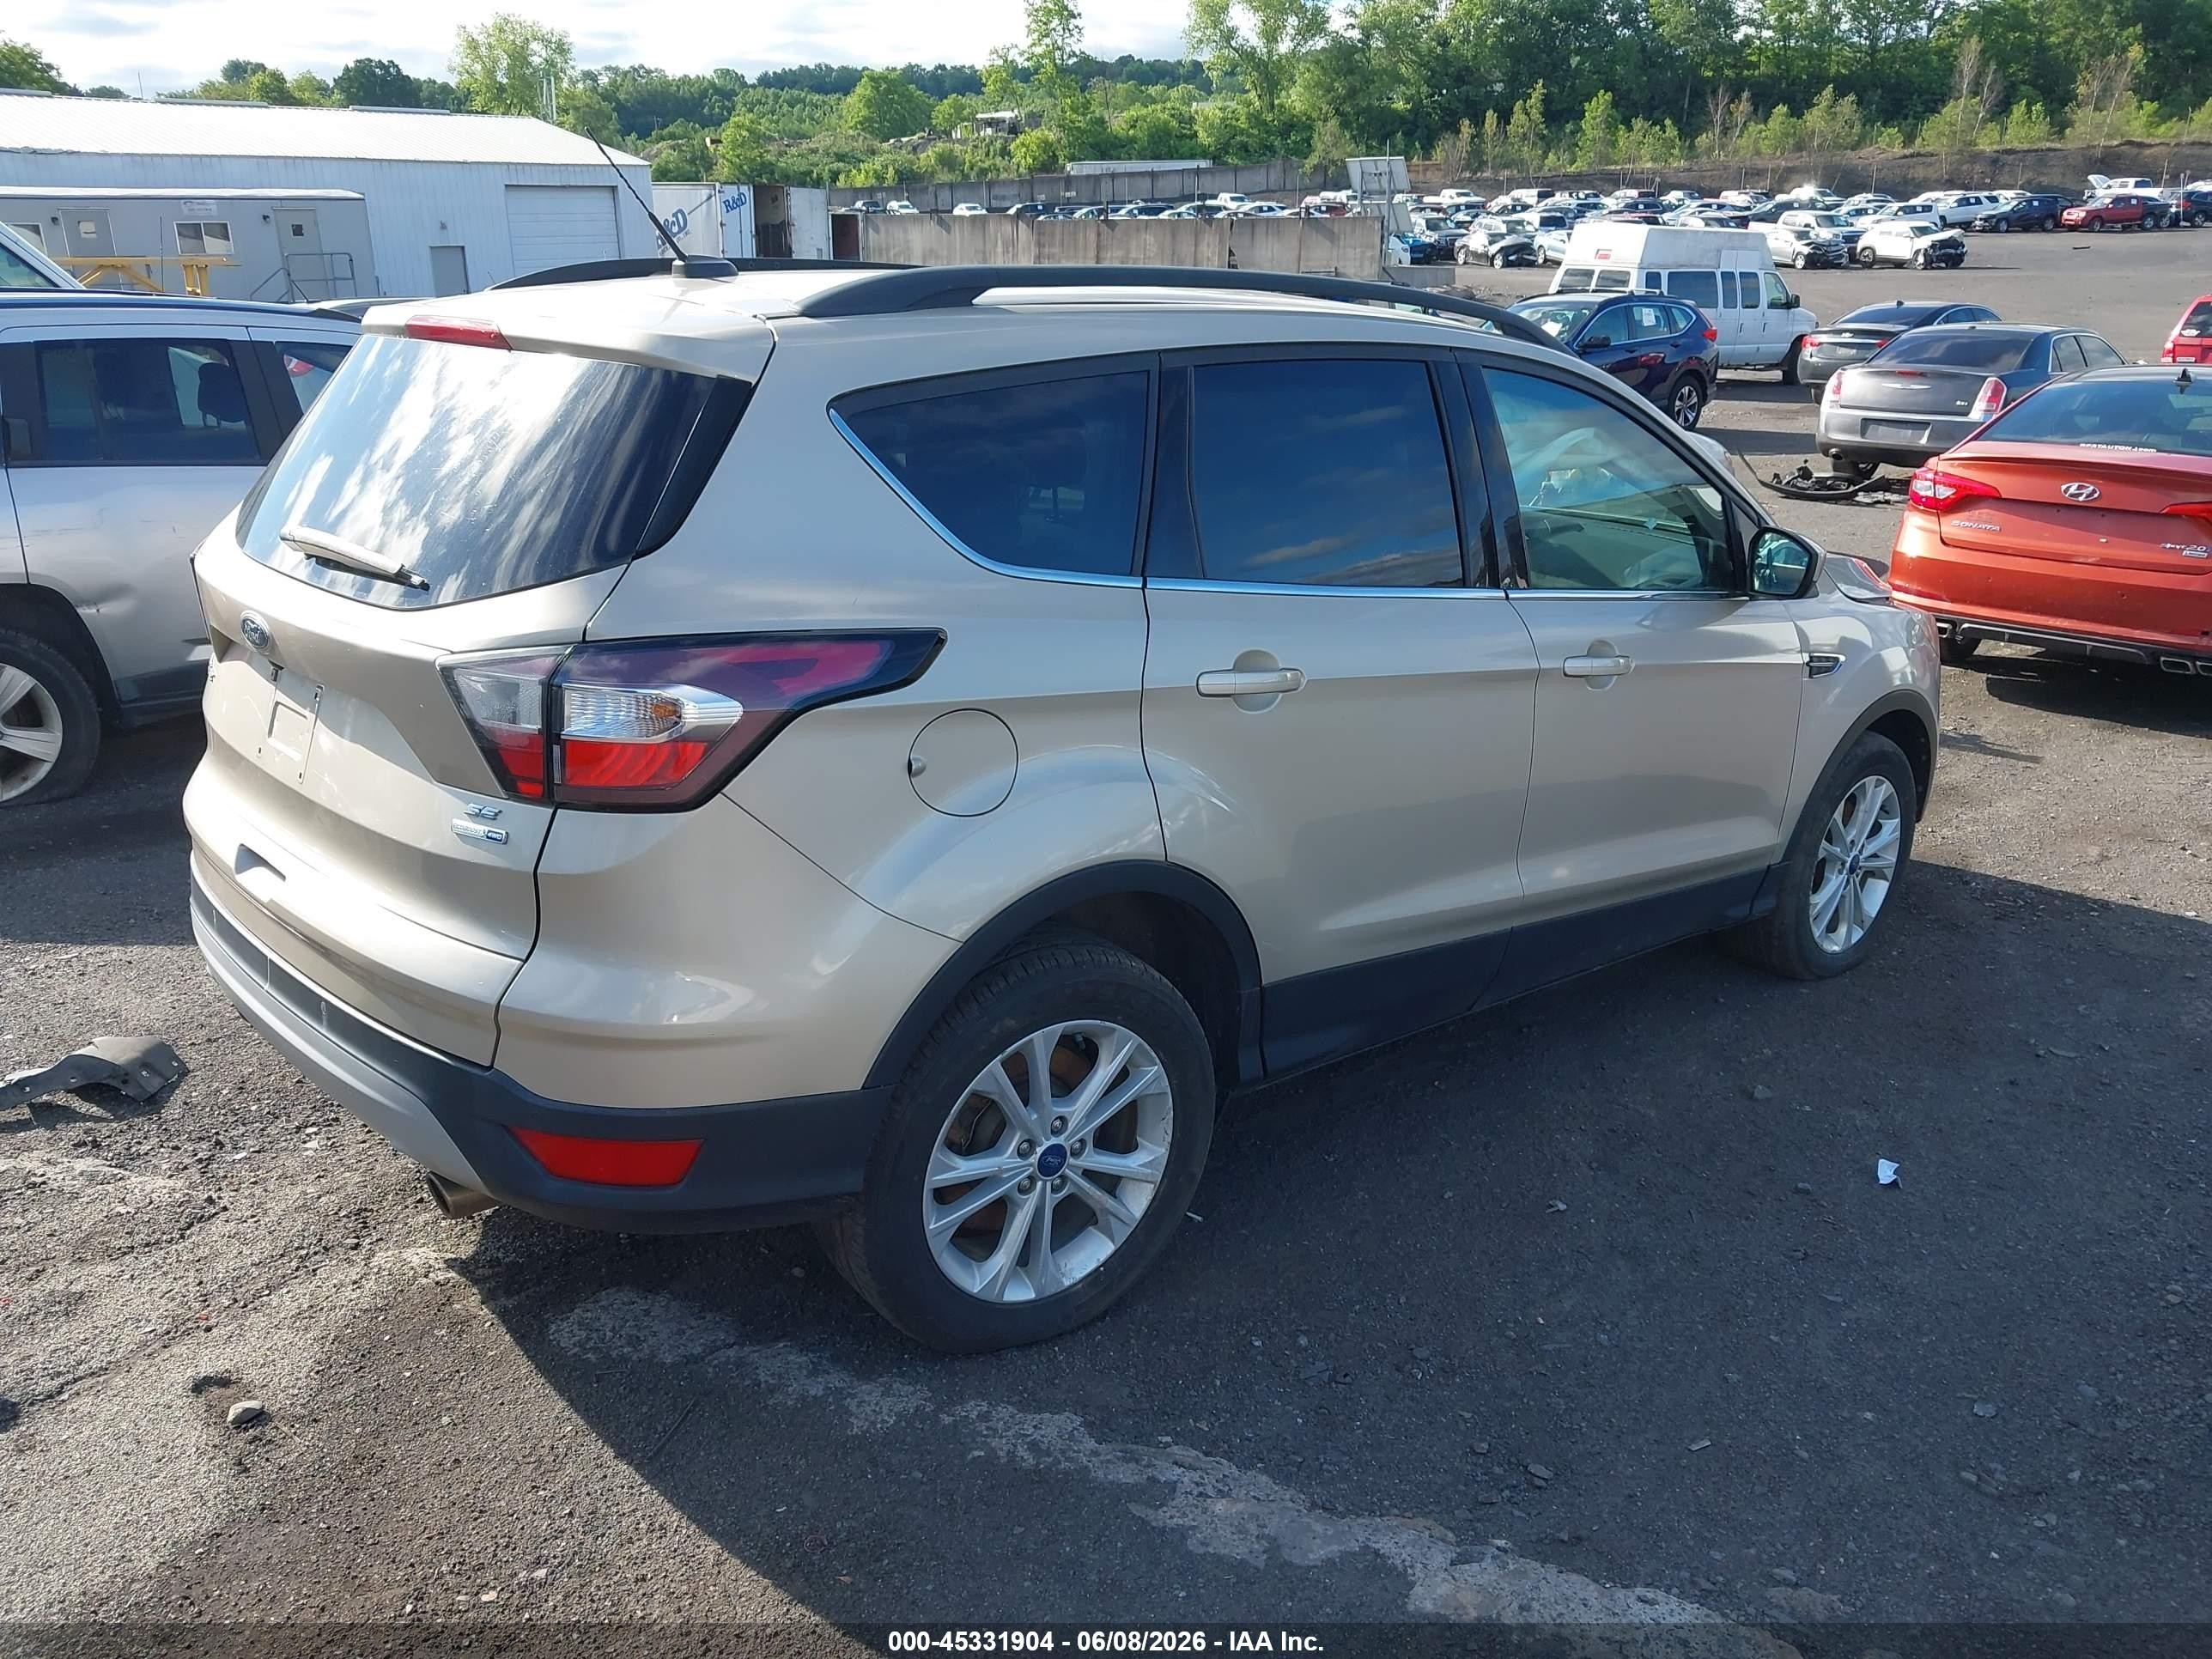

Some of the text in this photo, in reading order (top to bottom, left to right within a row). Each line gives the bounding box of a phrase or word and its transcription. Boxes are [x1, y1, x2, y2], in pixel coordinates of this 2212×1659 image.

[722, 192, 747, 213] R&D
[1950, 520, 2002, 532] SONATA
[464, 803, 502, 820] SE
[487, 830, 503, 841] 4WD
